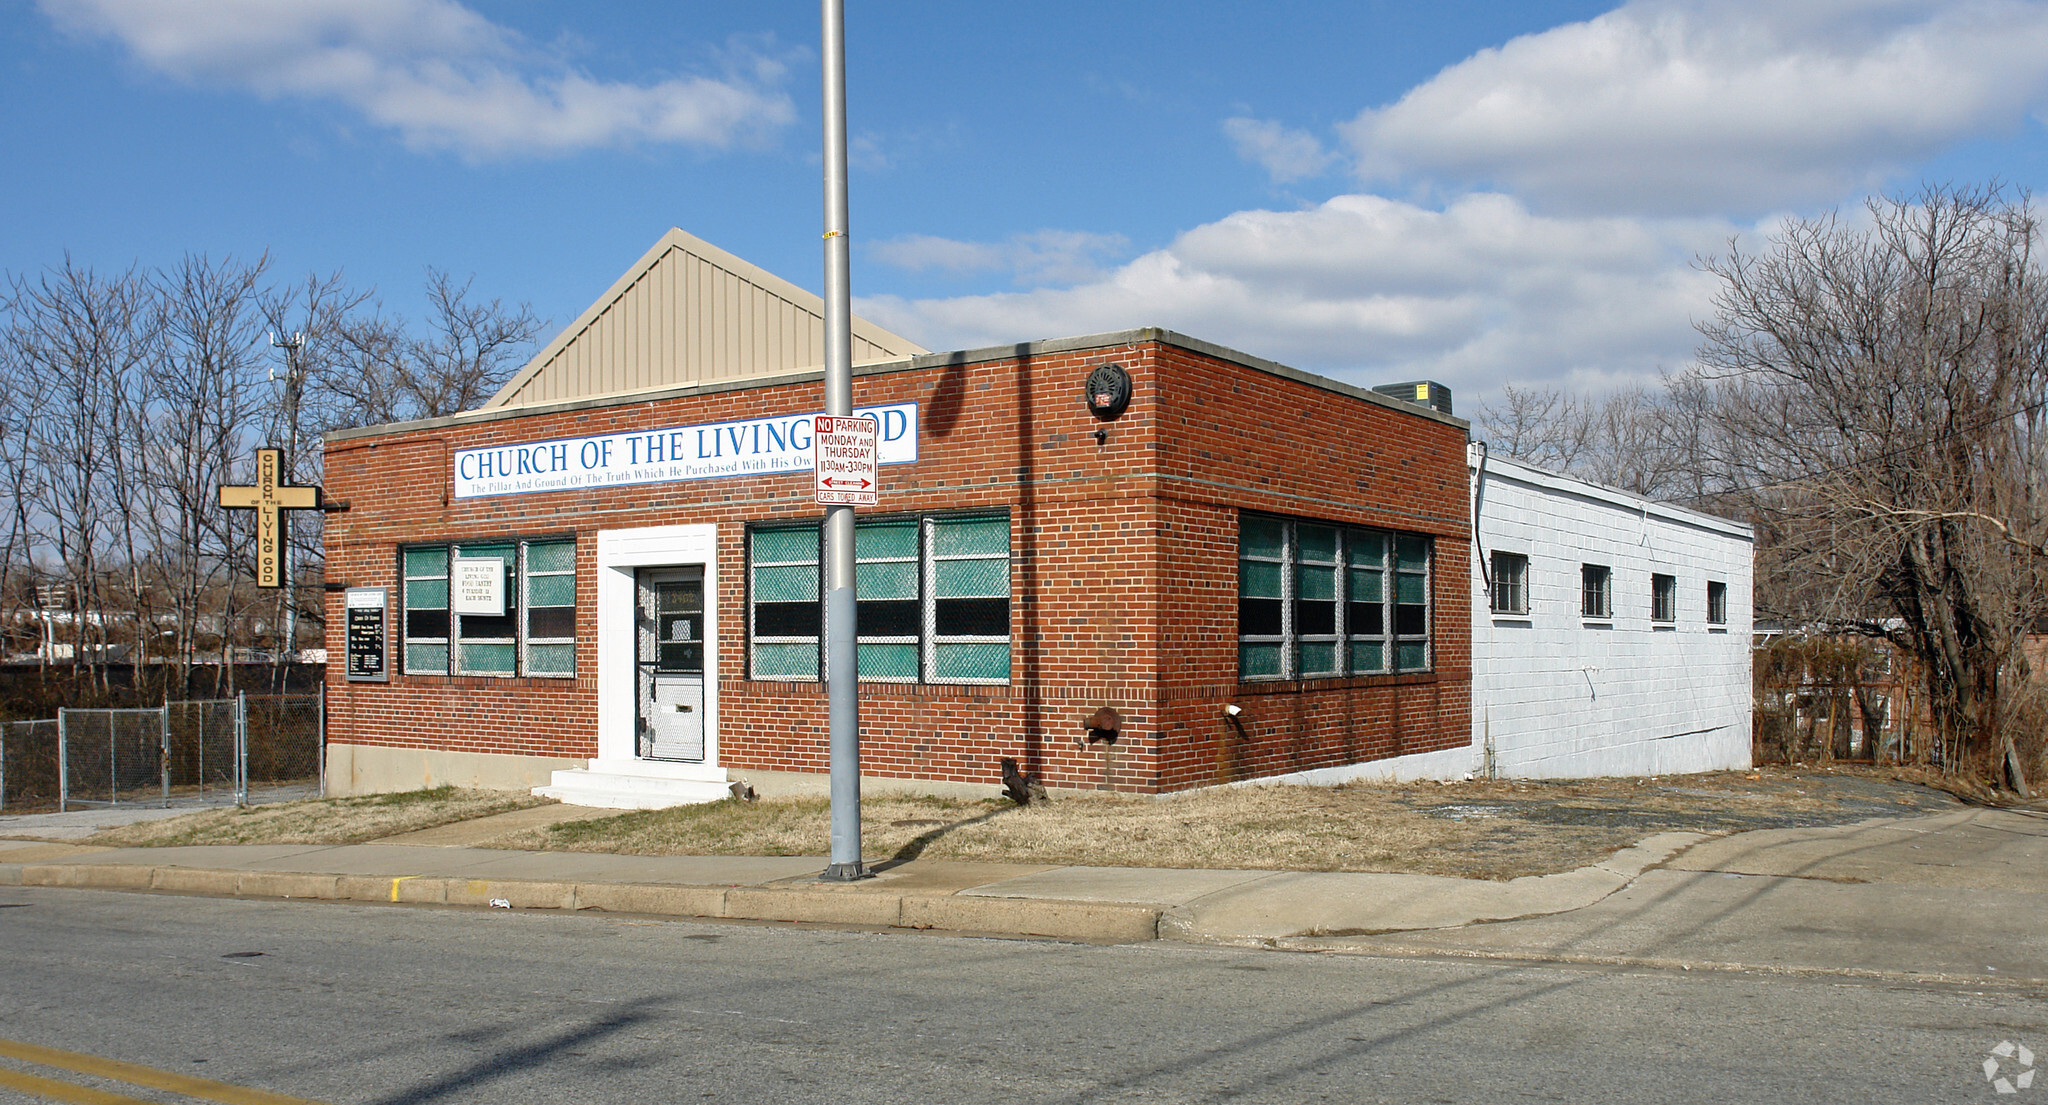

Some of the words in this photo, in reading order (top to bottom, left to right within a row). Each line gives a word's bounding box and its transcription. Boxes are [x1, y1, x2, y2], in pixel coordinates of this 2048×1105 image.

[817, 418, 830, 431] NO
[836, 419, 873, 433] PARKING
[461, 444, 568, 480] CHURCH
[581, 440, 613, 470] OF
[626, 432, 684, 465] THE
[697, 419, 811, 459] LIVING
[821, 434, 857, 446] MONDAY
[859, 438, 873, 447] AND
[825, 446, 871, 459] THURSDAY
[263, 454, 273, 499] CHURCH
[471, 484, 486, 493] The
[489, 482, 512, 492] Pillar
[515, 479, 531, 490] And
[535, 476, 567, 488] Ground
[570, 475, 582, 485] Of
[586, 473, 602, 483] The
[606, 470, 631, 482] Truth
[634, 467, 664, 479] Which
[670, 466, 682, 476] He
[686, 461, 737, 475] Purchased
[742, 459, 766, 470] With
[771, 457, 789, 468] His
[793, 455, 812, 466] Ow
[819, 492, 834, 501] CARS
[837, 493, 855, 502] TOWED
[859, 494, 874, 502] AWAY
[263, 506, 273, 553] LIVING
[263, 557, 273, 583] GOD
